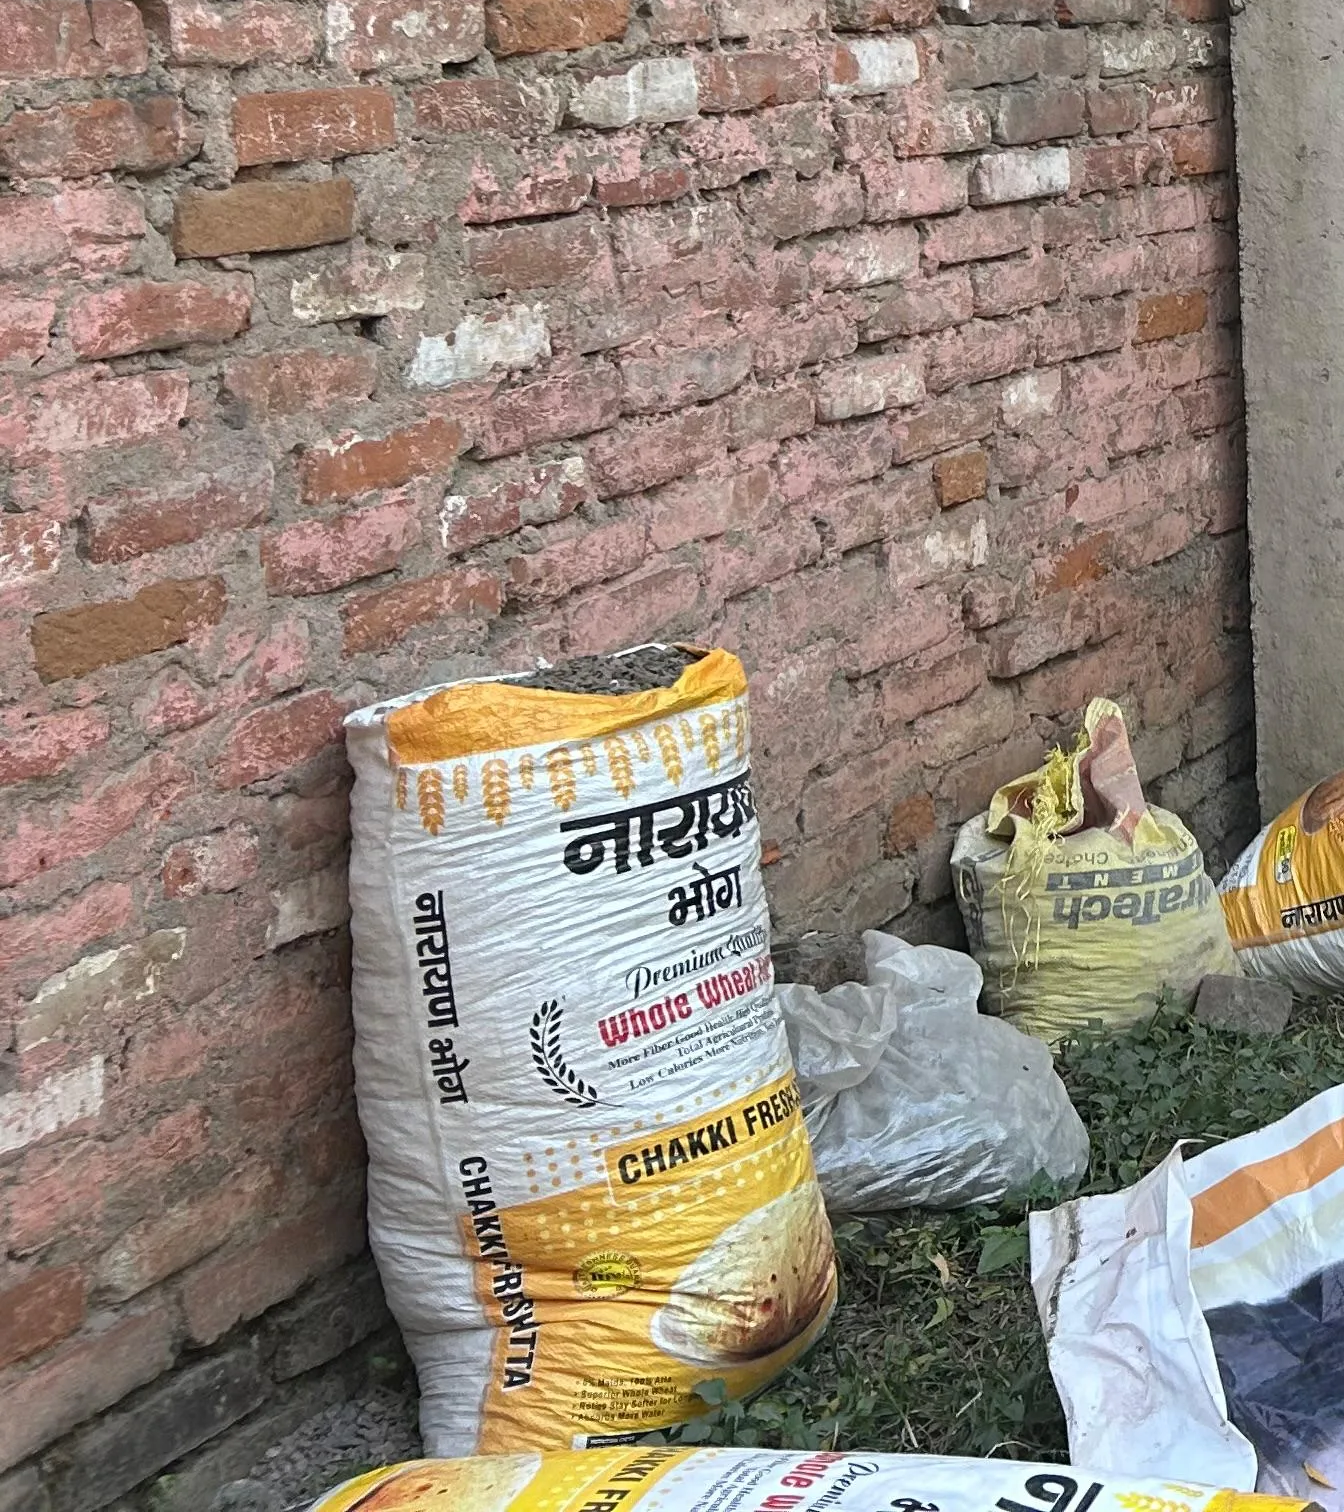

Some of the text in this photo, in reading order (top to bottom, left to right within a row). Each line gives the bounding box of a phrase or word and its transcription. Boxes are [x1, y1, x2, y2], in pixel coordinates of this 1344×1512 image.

[668, 861, 742, 927] भोग
[413, 890, 470, 1105] नारायण भोग
[625, 945, 726, 1000] Premium
[597, 991, 694, 1048] Whole
[608, 1050, 641, 1071] More
[643, 1037, 673, 1058] Fiber
[628, 1073, 655, 1091] Low
[617, 1085, 797, 1185] CHAKKI FRESH
[458, 1156, 510, 1261] CHAKKI
